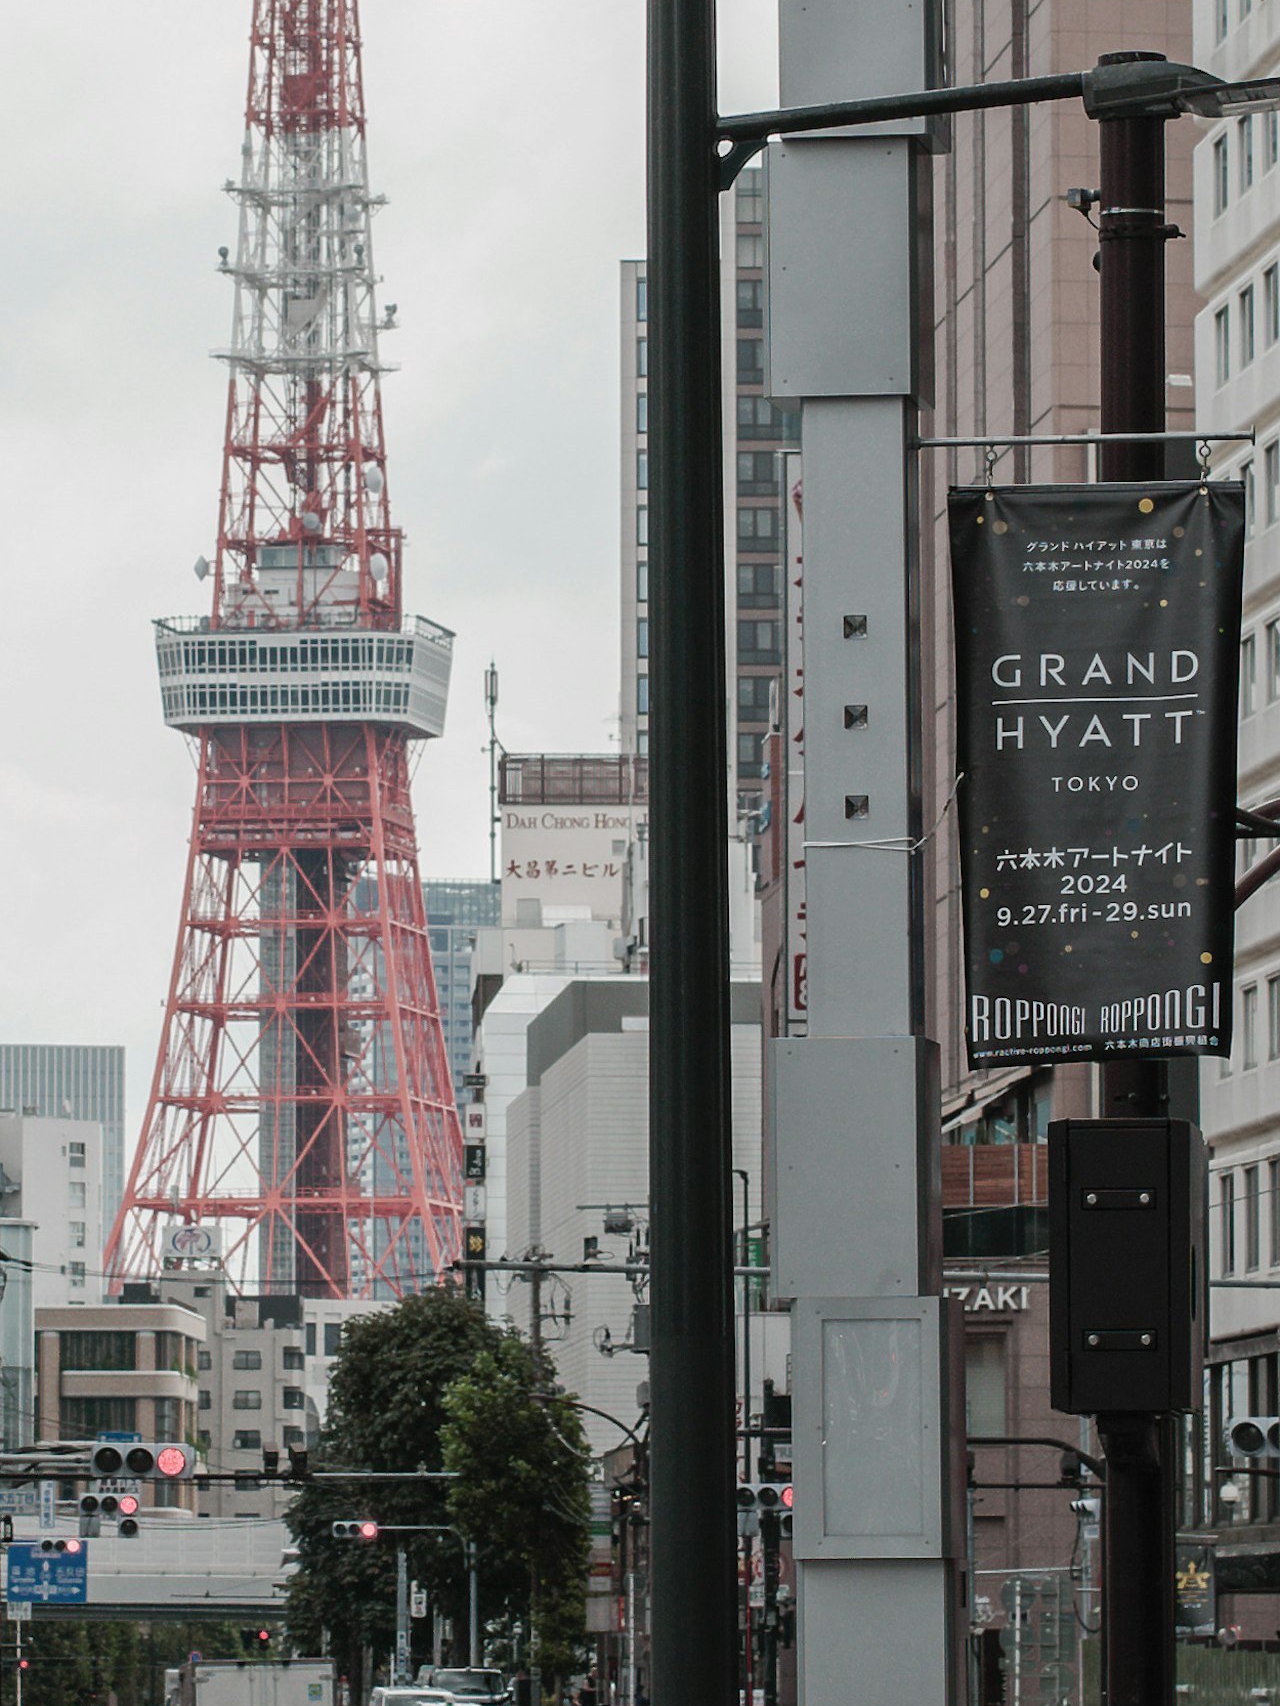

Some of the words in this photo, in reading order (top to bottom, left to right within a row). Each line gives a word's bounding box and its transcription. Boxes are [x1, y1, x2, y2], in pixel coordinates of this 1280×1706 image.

[1026, 540, 1070, 553] グランド
[1072, 538, 1127, 552] ハイアット
[1131, 538, 1167, 551] 東京は
[1022, 558, 1170, 572] 六本木アートナイト2024を
[990, 649, 1200, 689] GRAND
[1052, 774, 1140, 793] TOKYO
[995, 843, 1194, 872] 六本木アートナイト
[506, 859, 620, 879] 大昌第二ビル
[1060, 873, 1128, 895] 2024
[972, 994, 1086, 1043] ROPPONGI
[1100, 982, 1221, 1034] ROPPONGI
